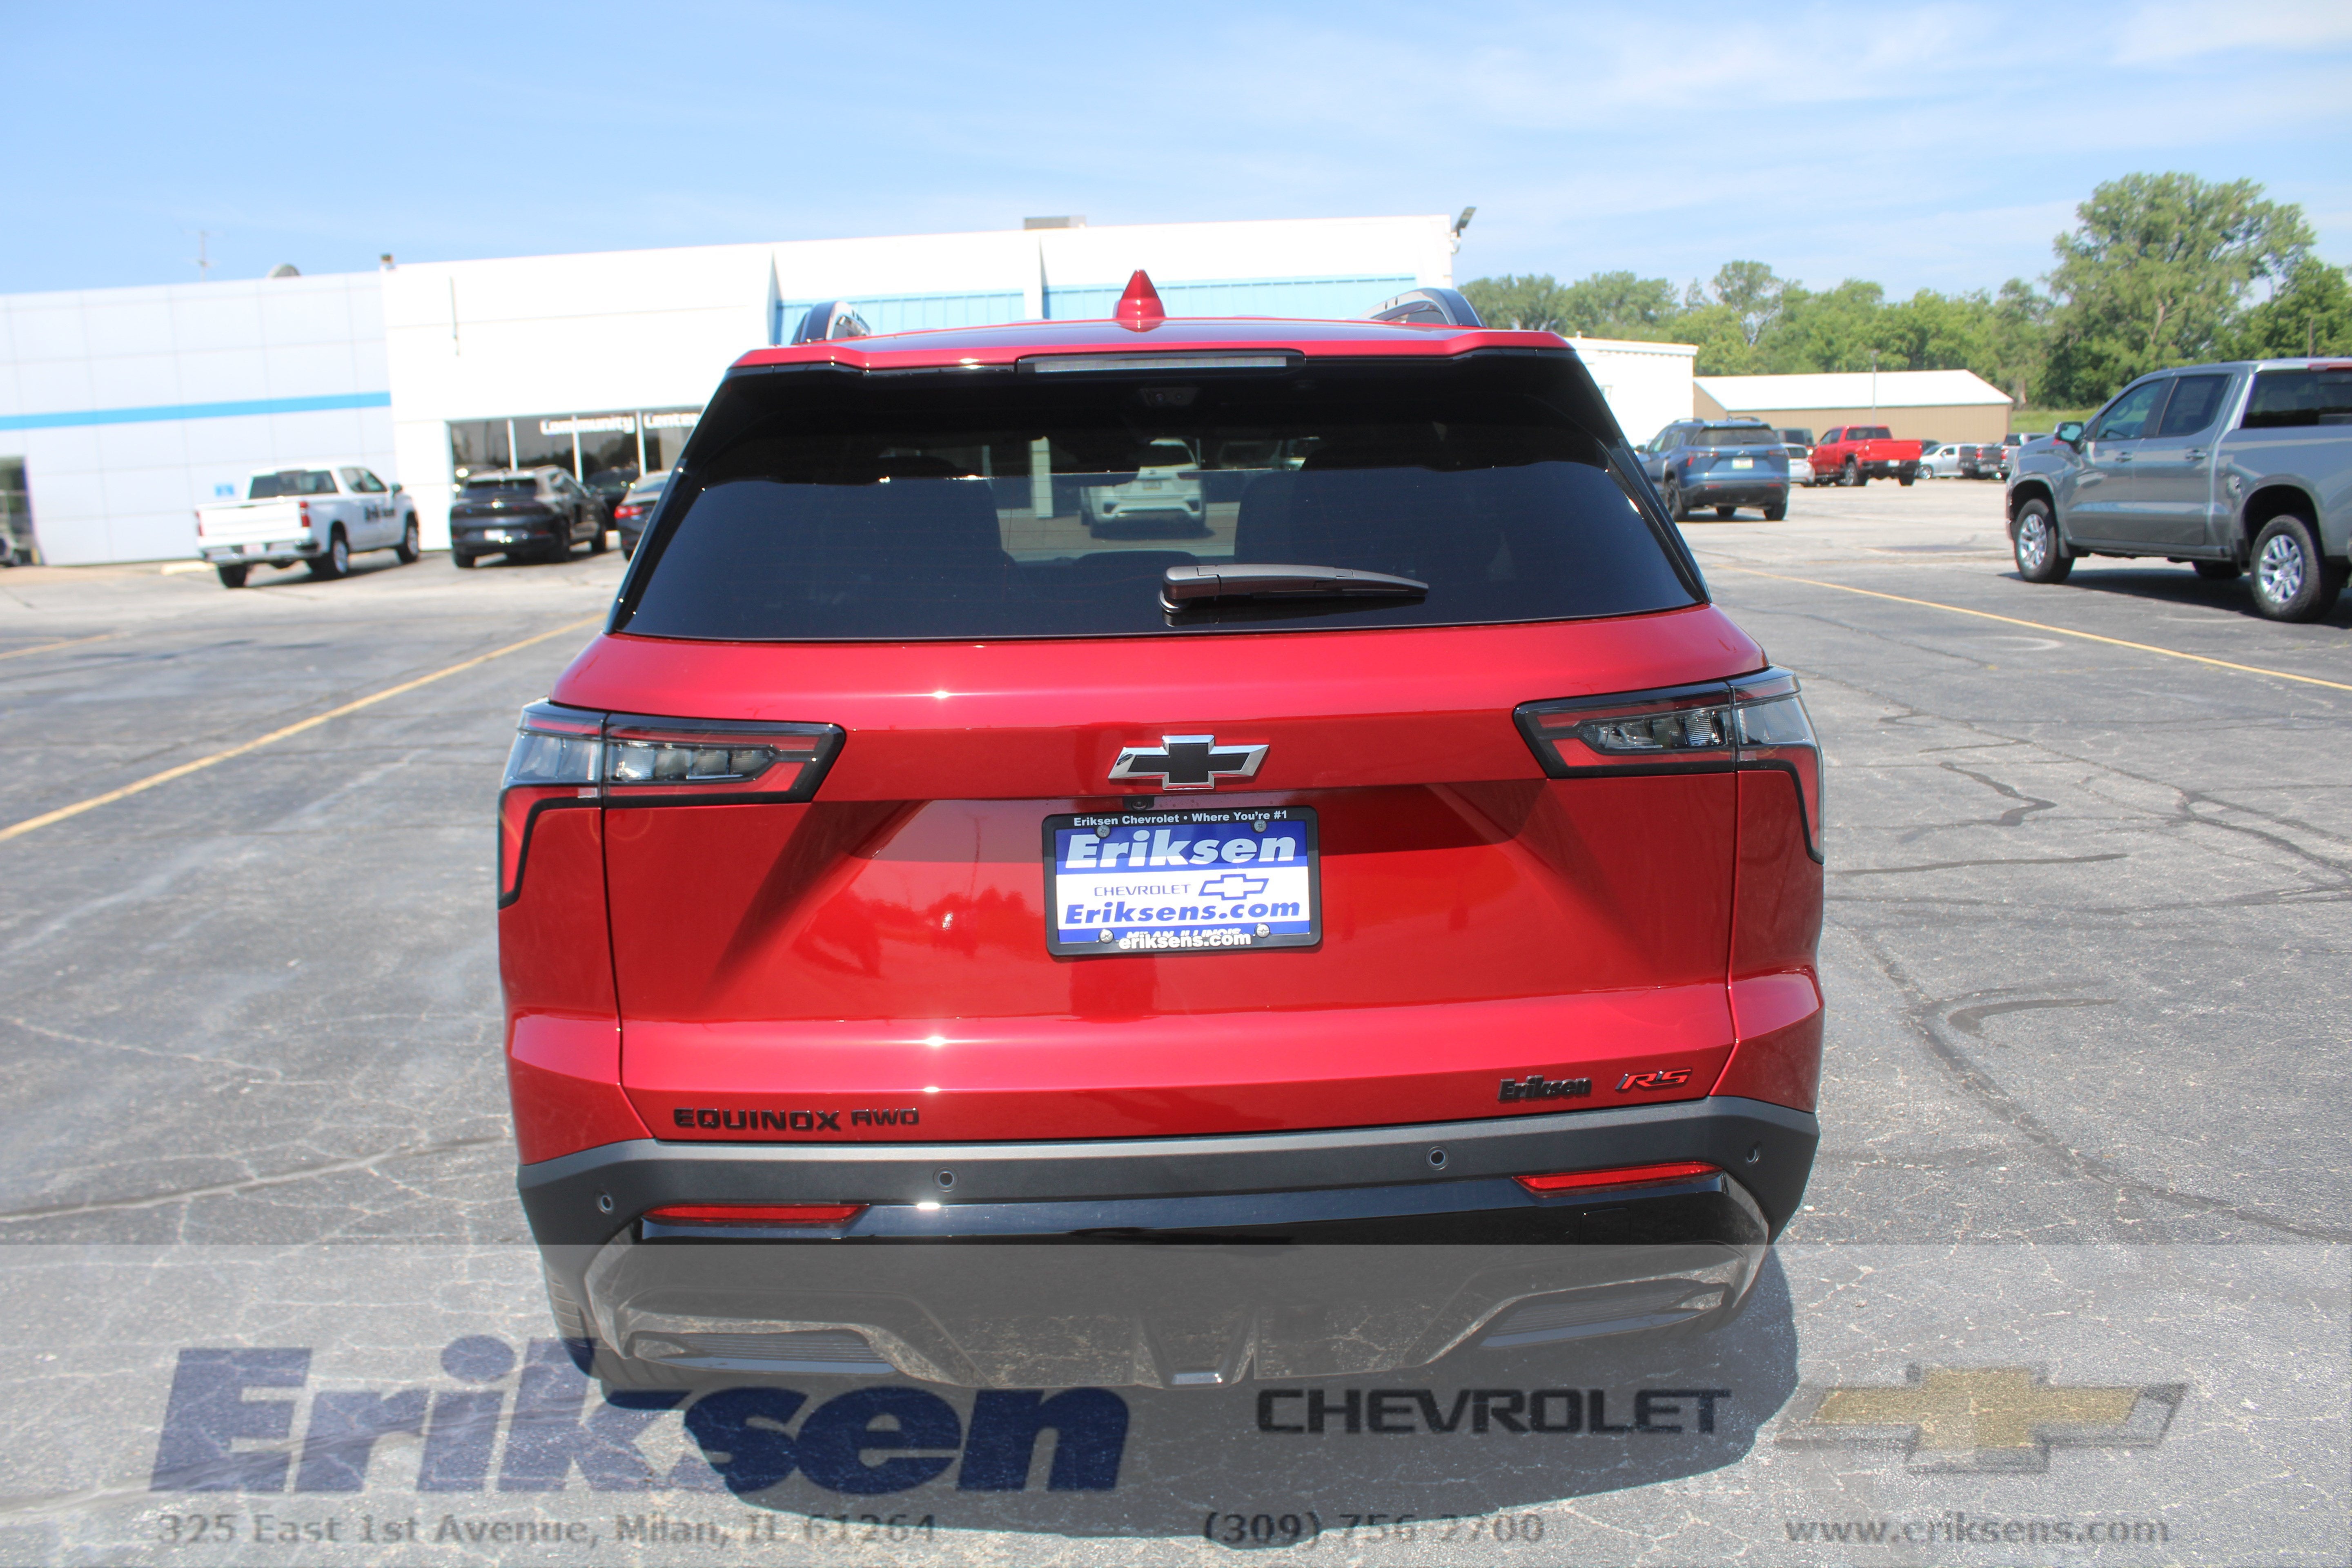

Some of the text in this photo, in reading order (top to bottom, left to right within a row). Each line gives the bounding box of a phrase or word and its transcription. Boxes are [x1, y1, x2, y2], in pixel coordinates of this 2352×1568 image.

[1074, 816, 1120, 826] Eriksen
[1122, 815, 1179, 824] Chevrolet
[1192, 813, 1230, 822] Where
[1274, 810, 1287, 819] #1
[1065, 829, 1296, 869] Eriksen
[1094, 884, 1191, 897] CHEVROLET
[1065, 901, 1301, 924] Eriksens.com
[1118, 932, 1251, 950] eriksens.com
[1497, 1075, 1592, 1101] Eriksen
[1615, 1068, 1693, 1091] RS
[673, 1107, 920, 1131] EQUINOX AWD
